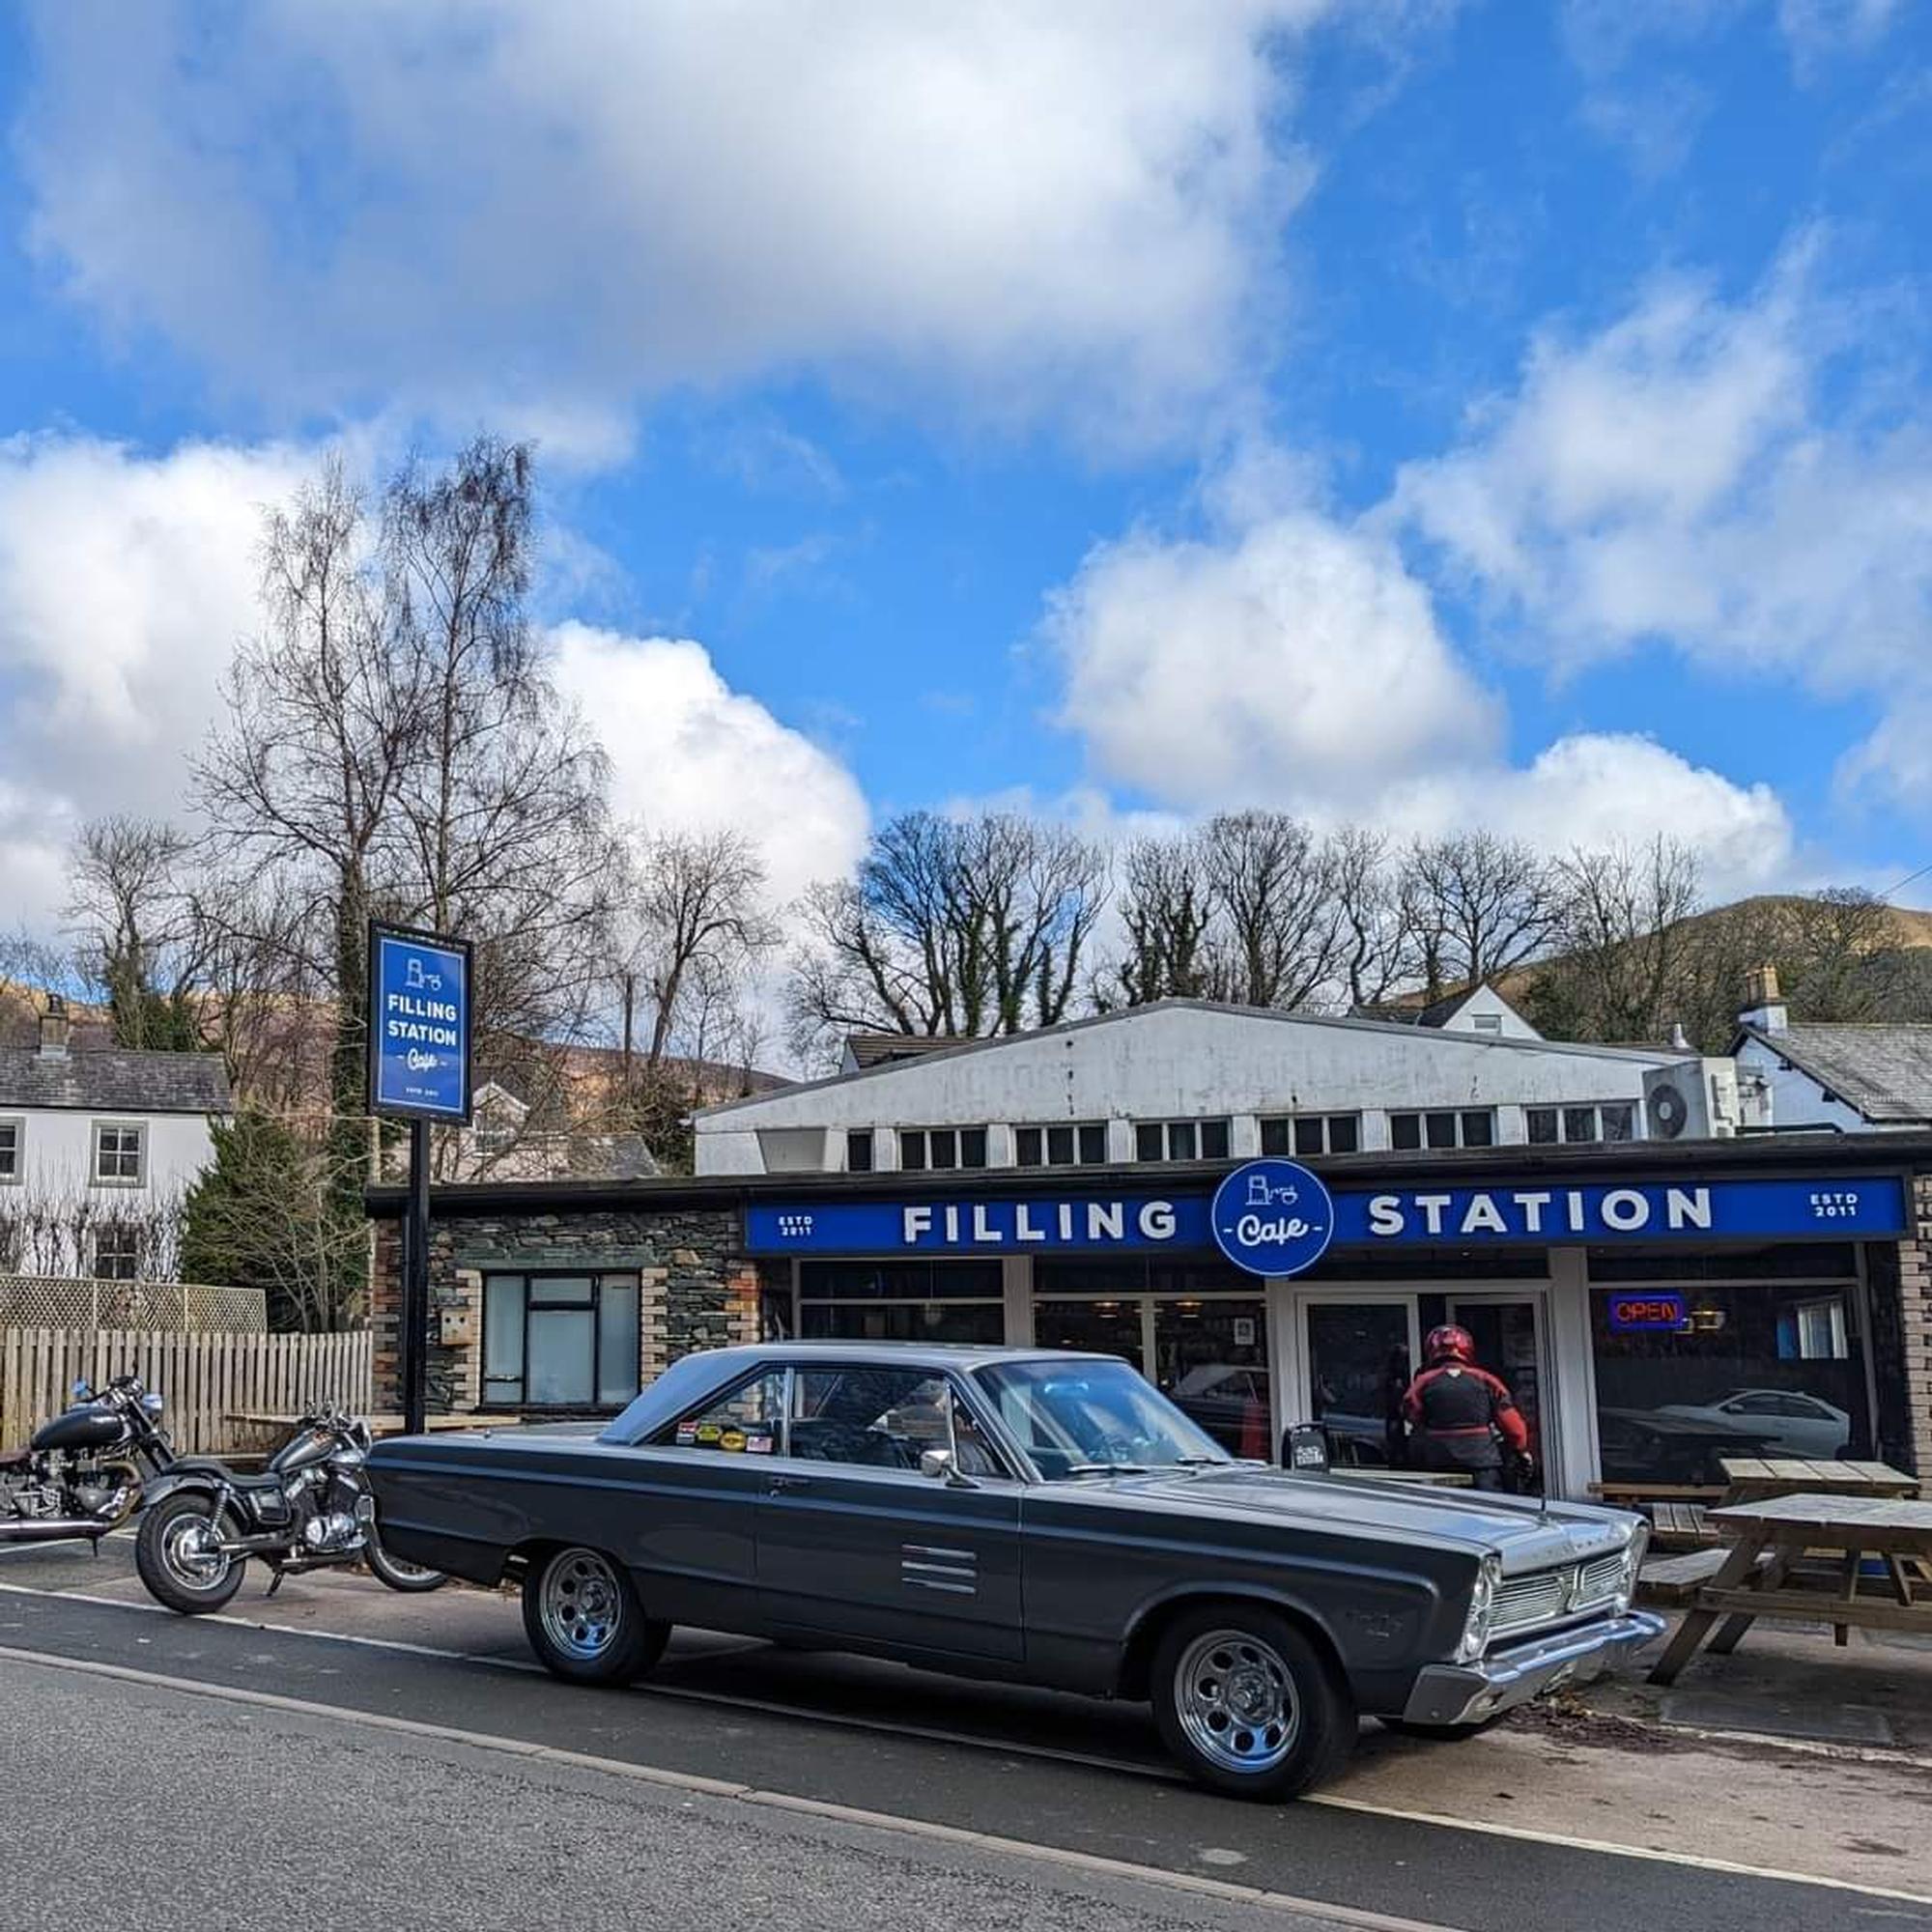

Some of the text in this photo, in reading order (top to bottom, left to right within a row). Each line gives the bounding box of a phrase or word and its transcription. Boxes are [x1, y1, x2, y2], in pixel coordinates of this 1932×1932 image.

[388, 994, 456, 1022] FILLING
[388, 1020, 457, 1046] STATION
[1810, 1193, 1858, 1205] ESTD
[779, 1216, 812, 1226] ESTD
[903, 1188, 1712, 1242] FILLING STATION
[1816, 1206, 1856, 1217] 2011
[1237, 1214, 1308, 1246] Cafe
[1617, 1302, 1678, 1321] OPEN
